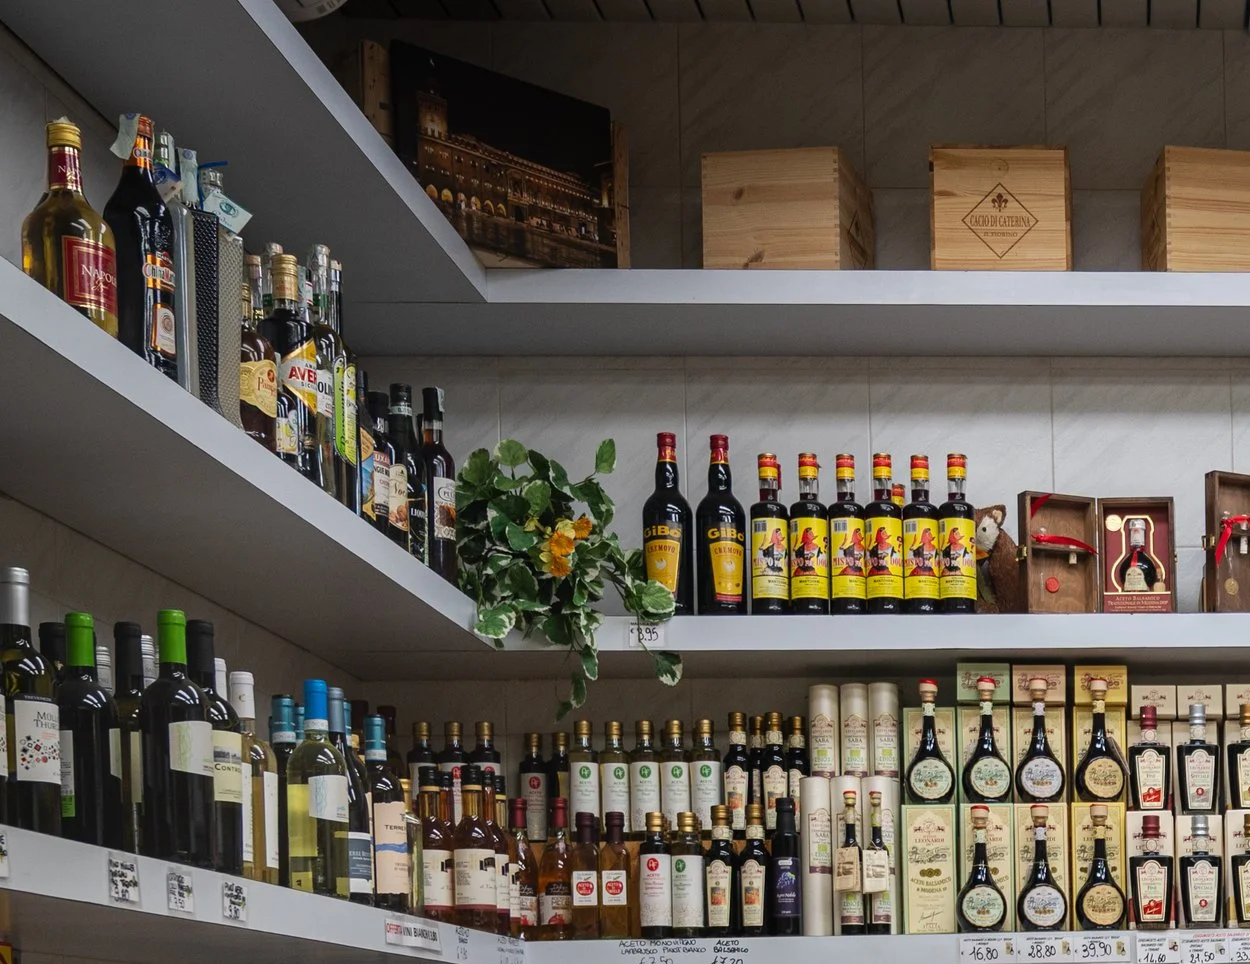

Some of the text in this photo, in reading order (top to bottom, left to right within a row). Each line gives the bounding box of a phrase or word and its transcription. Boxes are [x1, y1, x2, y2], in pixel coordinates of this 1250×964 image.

[970, 215, 1030, 228] CACIO DI CATERINA
[619, 940, 646, 948] ACETO
[714, 946, 749, 954] BALSAMICO
